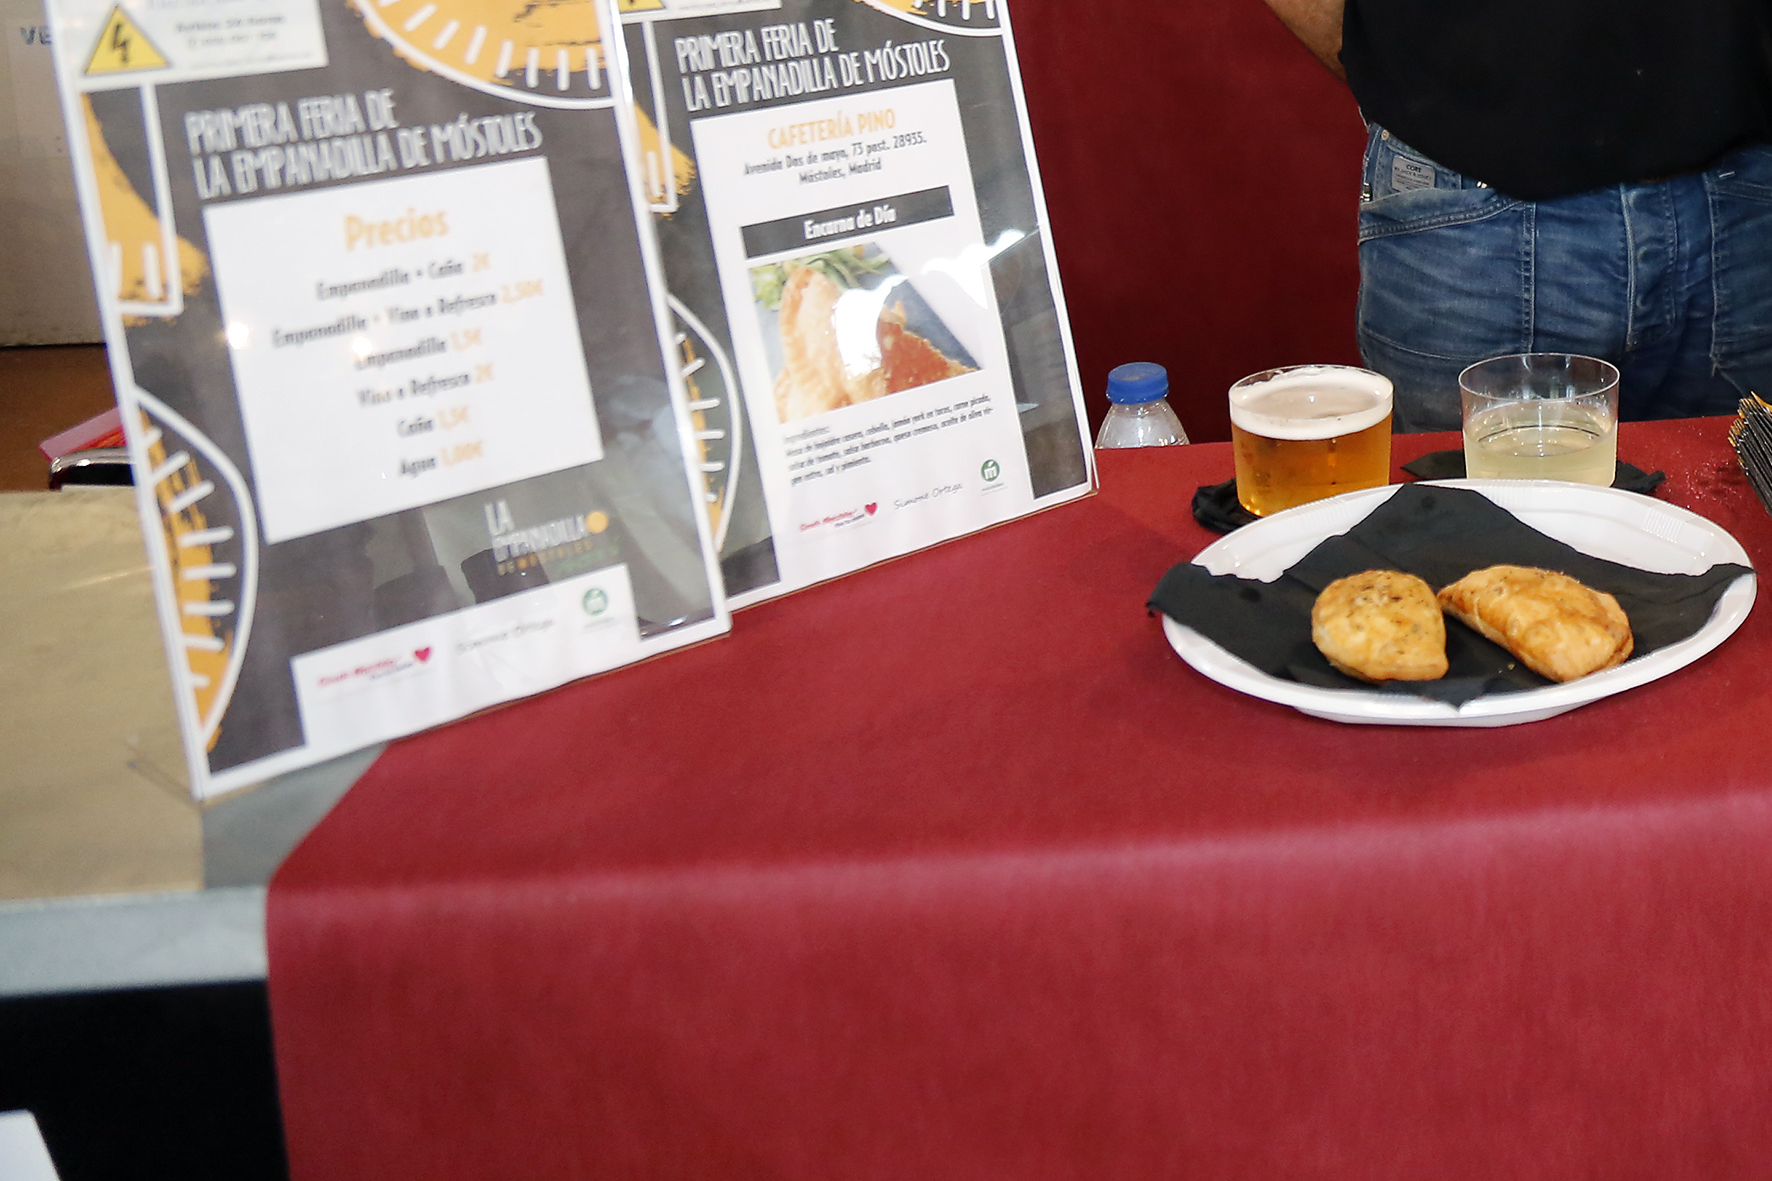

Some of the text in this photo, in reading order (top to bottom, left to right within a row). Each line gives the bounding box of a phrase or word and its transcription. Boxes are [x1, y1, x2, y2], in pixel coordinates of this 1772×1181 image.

[674, 19, 839, 73] PRIMERA FERIA DE
[682, 39, 951, 112] LA EMPANADILLA DE MÓSTOLES
[768, 109, 895, 150] CAFETERÍA PINO
[803, 204, 896, 238] Encarna de Día
